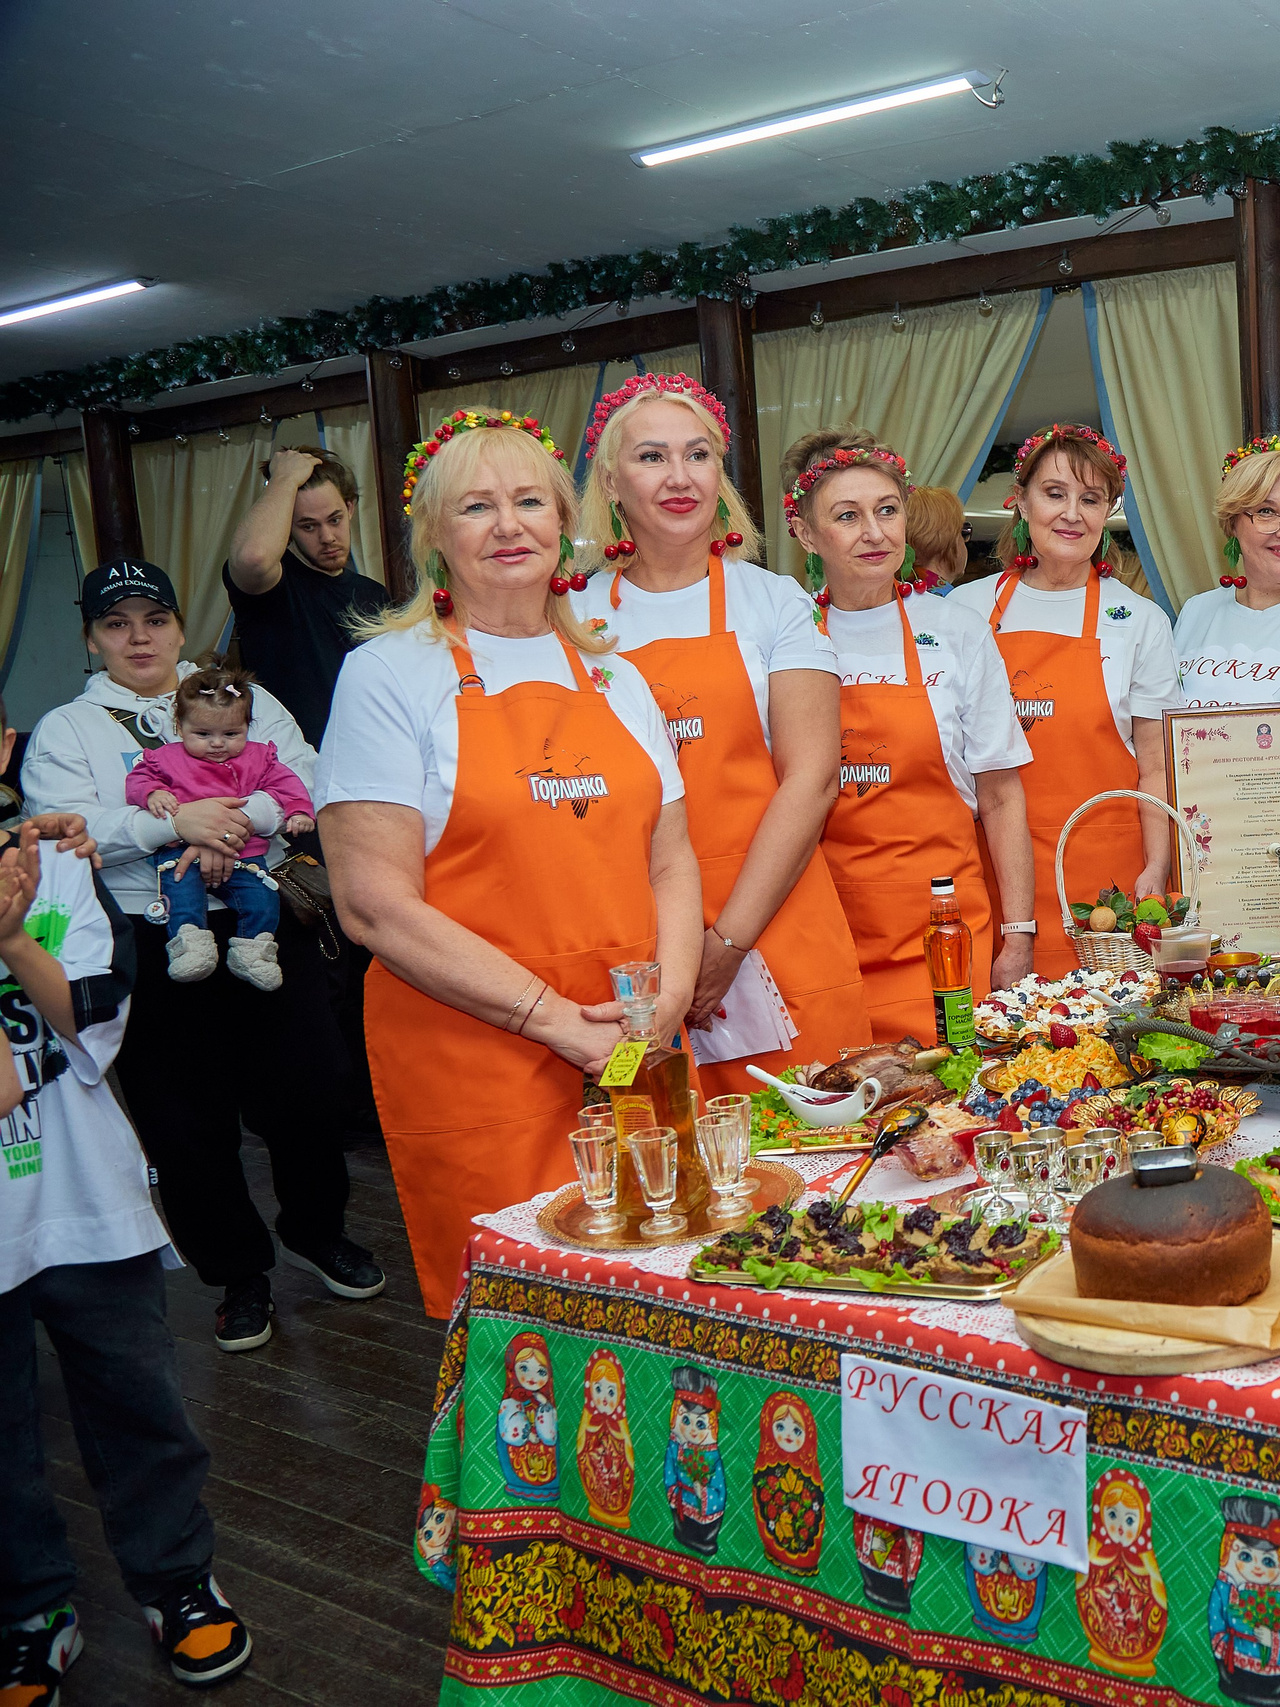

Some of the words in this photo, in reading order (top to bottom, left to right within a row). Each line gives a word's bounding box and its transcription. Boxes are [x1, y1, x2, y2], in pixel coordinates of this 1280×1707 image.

[124, 580, 160, 593] EXCHANGE
[529, 775, 609, 808] Горлинка
[847, 1365, 1087, 1457] РУССКАЯ
[845, 1464, 1069, 1548] ЯГОДКА
